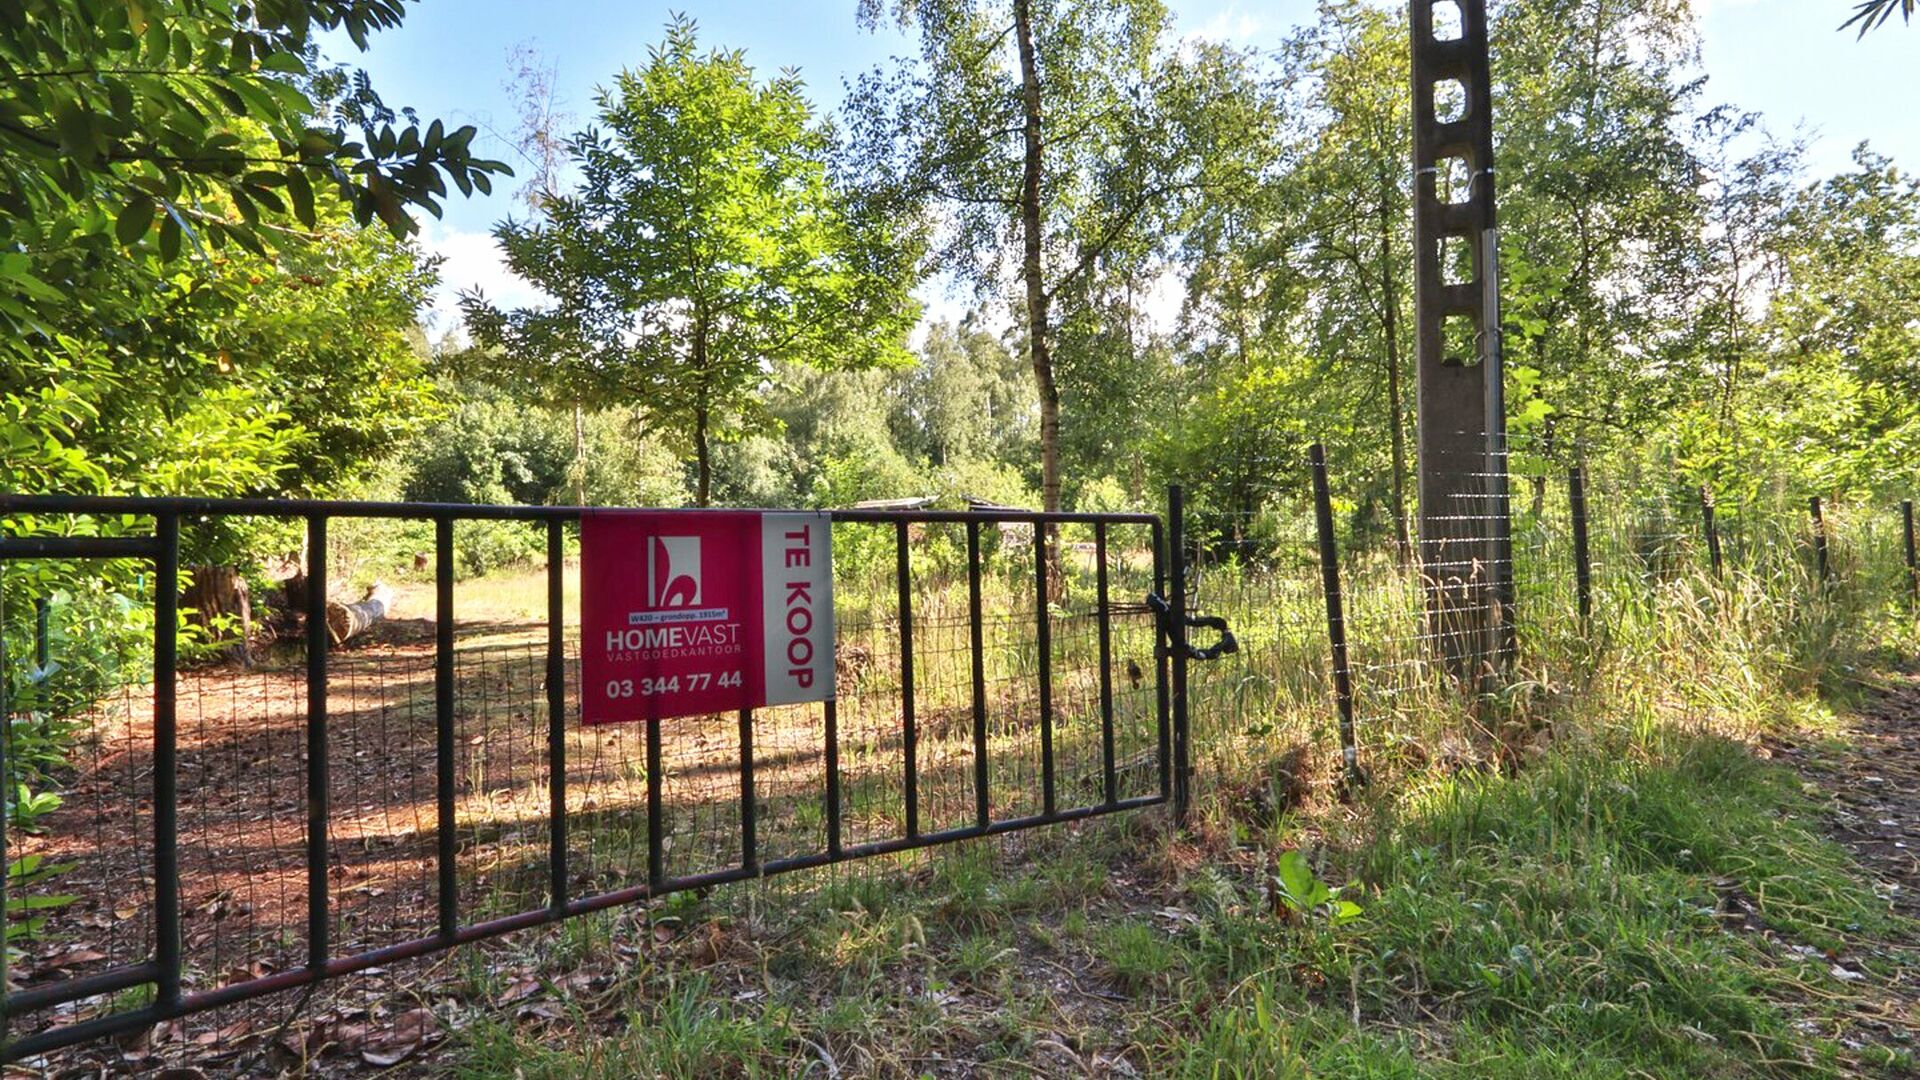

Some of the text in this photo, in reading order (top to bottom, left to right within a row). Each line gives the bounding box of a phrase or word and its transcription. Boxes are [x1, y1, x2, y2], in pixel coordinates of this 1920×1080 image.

[785, 525, 814, 688] TE KOOP
[606, 624, 741, 651] HOMEVAST
[607, 645, 741, 662] VASTGOEDKANTOOR
[606, 670, 742, 699] 03 344 77 44
